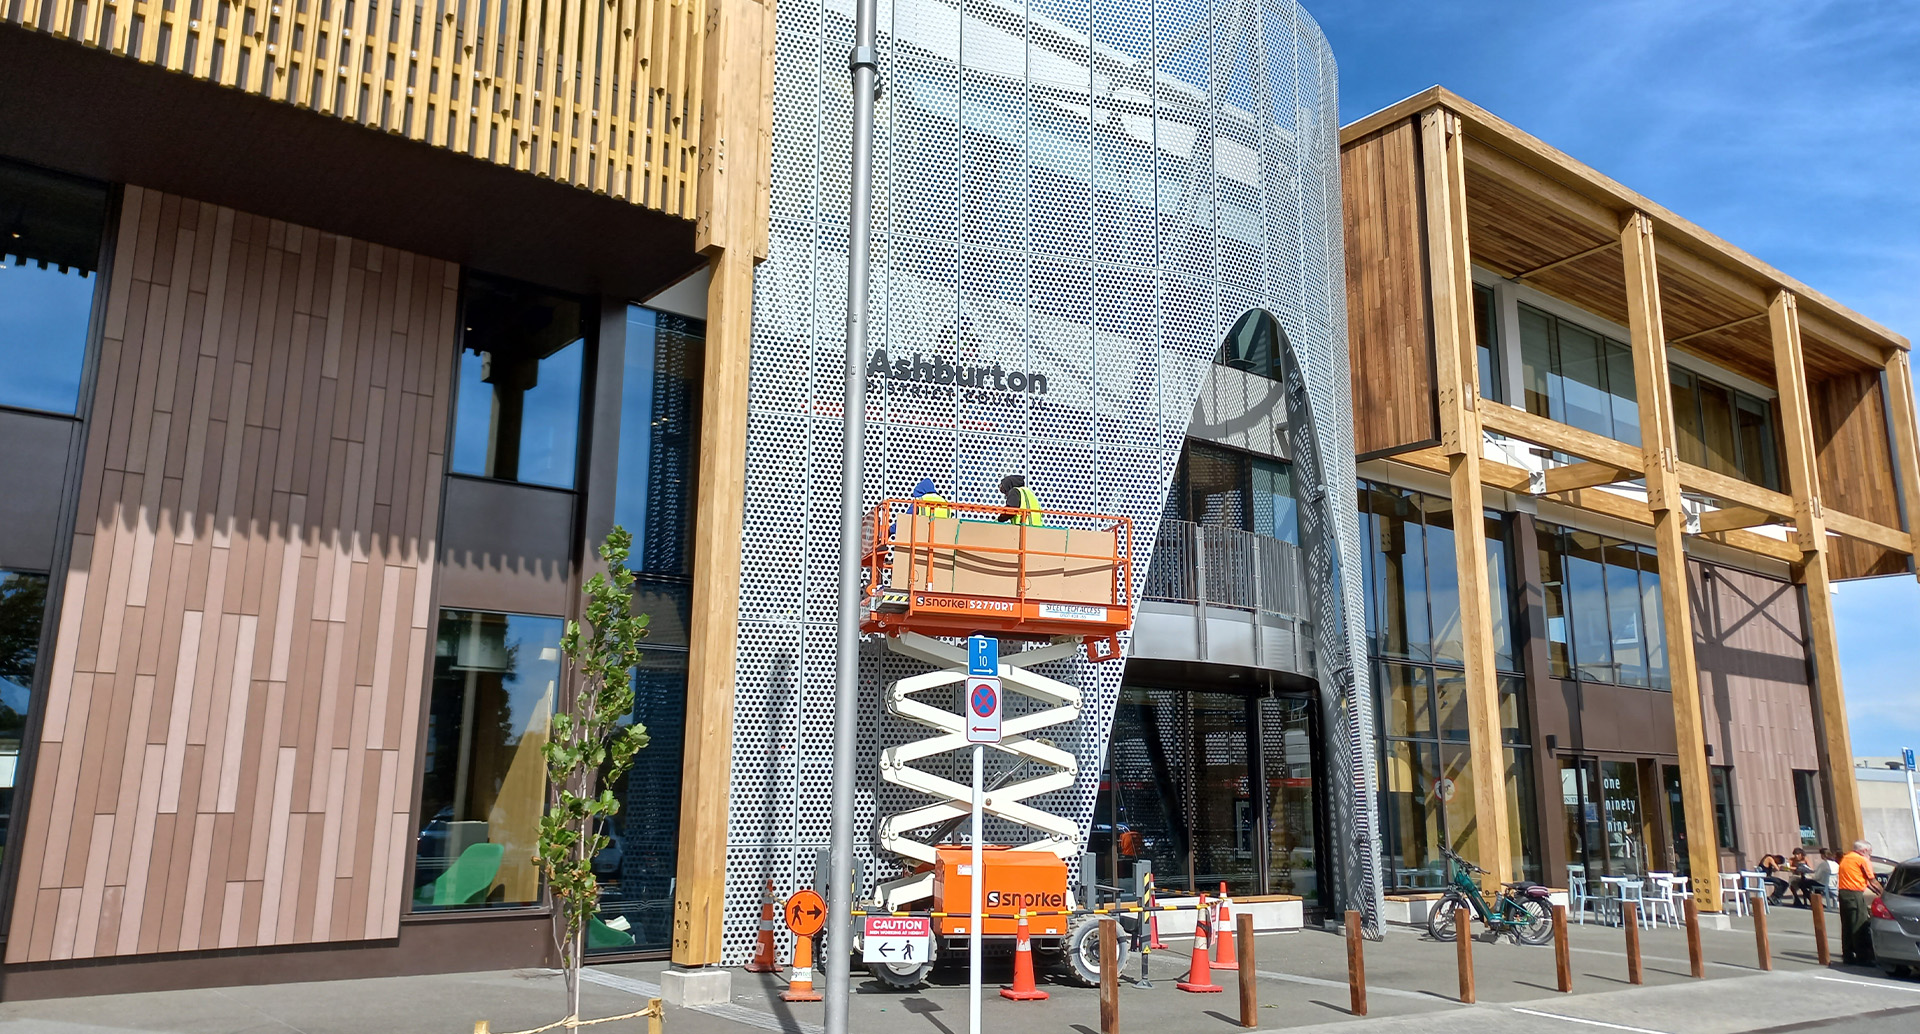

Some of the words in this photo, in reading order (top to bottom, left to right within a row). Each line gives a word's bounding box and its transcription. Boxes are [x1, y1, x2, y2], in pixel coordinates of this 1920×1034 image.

[867, 348, 1047, 394] Ashburton
[925, 597, 968, 608] snorkel
[969, 600, 1014, 611] S2770RT
[978, 639, 988, 654] P
[978, 655, 988, 667] 10
[1603, 778, 1620, 789] one
[1605, 796, 1636, 814] ninety
[1607, 818, 1628, 832] nine
[1002, 892, 1067, 907] snorkel
[873, 920, 923, 930] CAUTION
